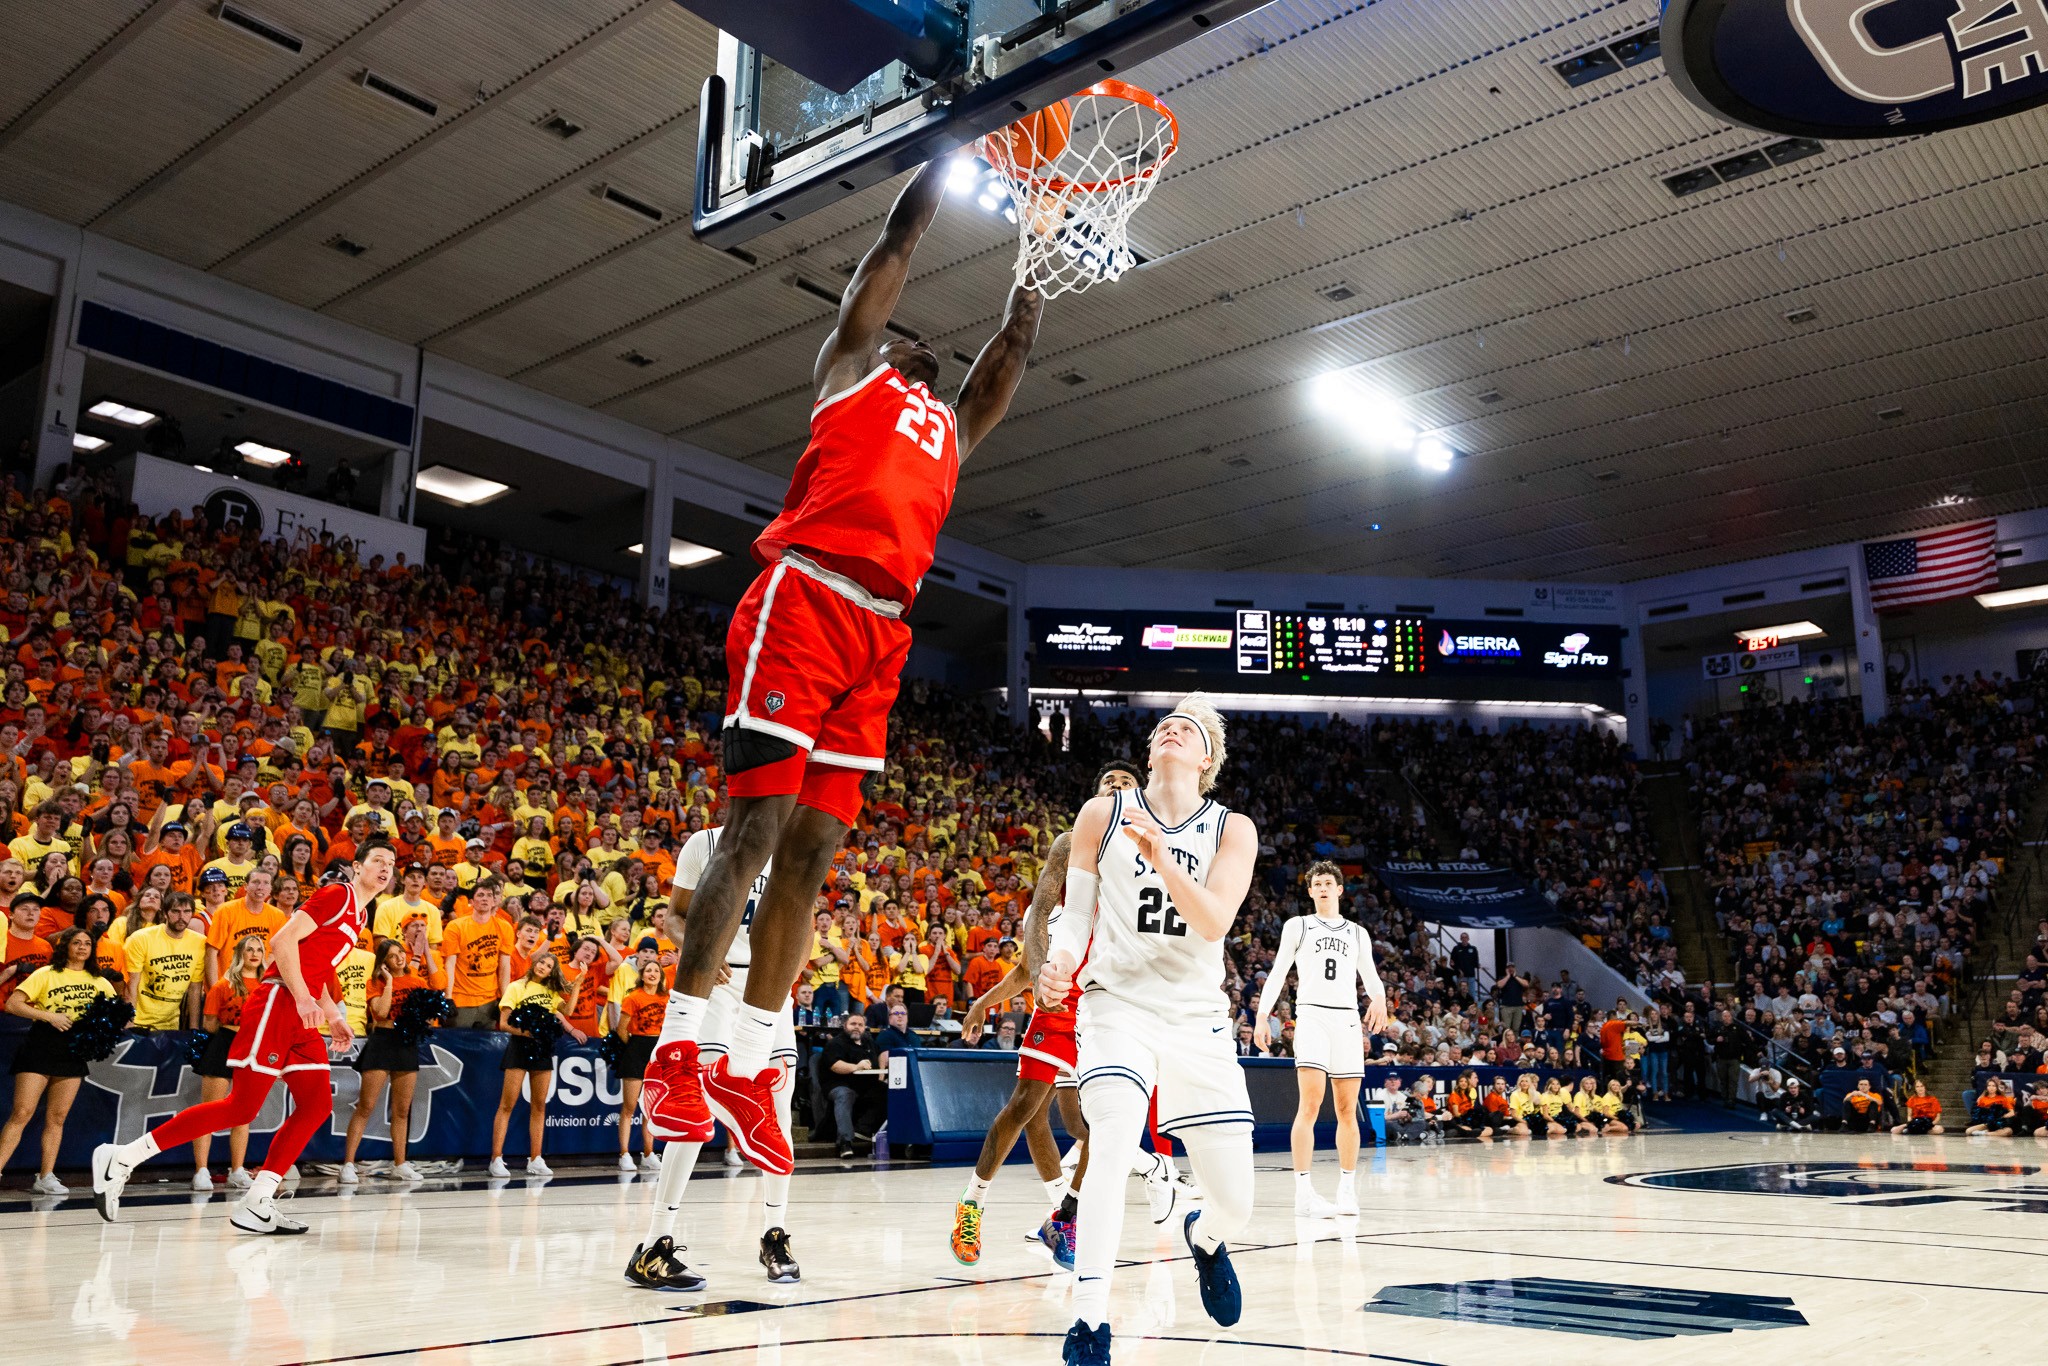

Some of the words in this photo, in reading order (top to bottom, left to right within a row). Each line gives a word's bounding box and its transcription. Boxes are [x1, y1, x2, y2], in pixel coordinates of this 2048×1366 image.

[1884, 107, 1905, 126] TM
[894, 392, 946, 460] 23
[653, 576, 665, 590] M
[1092, 634, 1124, 646] FIRST
[1176, 633, 1190, 642] LES
[1191, 633, 1228, 643] SCHWAB
[1455, 636, 1521, 651] SIERRA
[1543, 652, 1578, 668] Sign
[1580, 653, 1609, 666] Pro
[1863, 662, 1875, 673] R
[1386, 860, 1432, 871] UTAH
[1437, 861, 1490, 871] STATE
[1475, 887, 1526, 901] FIRST
[1138, 886, 1187, 937] 22
[1315, 936, 1349, 957] STATE
[149, 953, 193, 967] SPECTRUM
[162, 961, 191, 972] MAGIC
[1323, 957, 1337, 981] 8
[47, 983, 96, 999] SPECTRUM
[63, 991, 94, 1002] MAGIC
[545, 1115, 587, 1127] division
[589, 1114, 601, 1127] of
